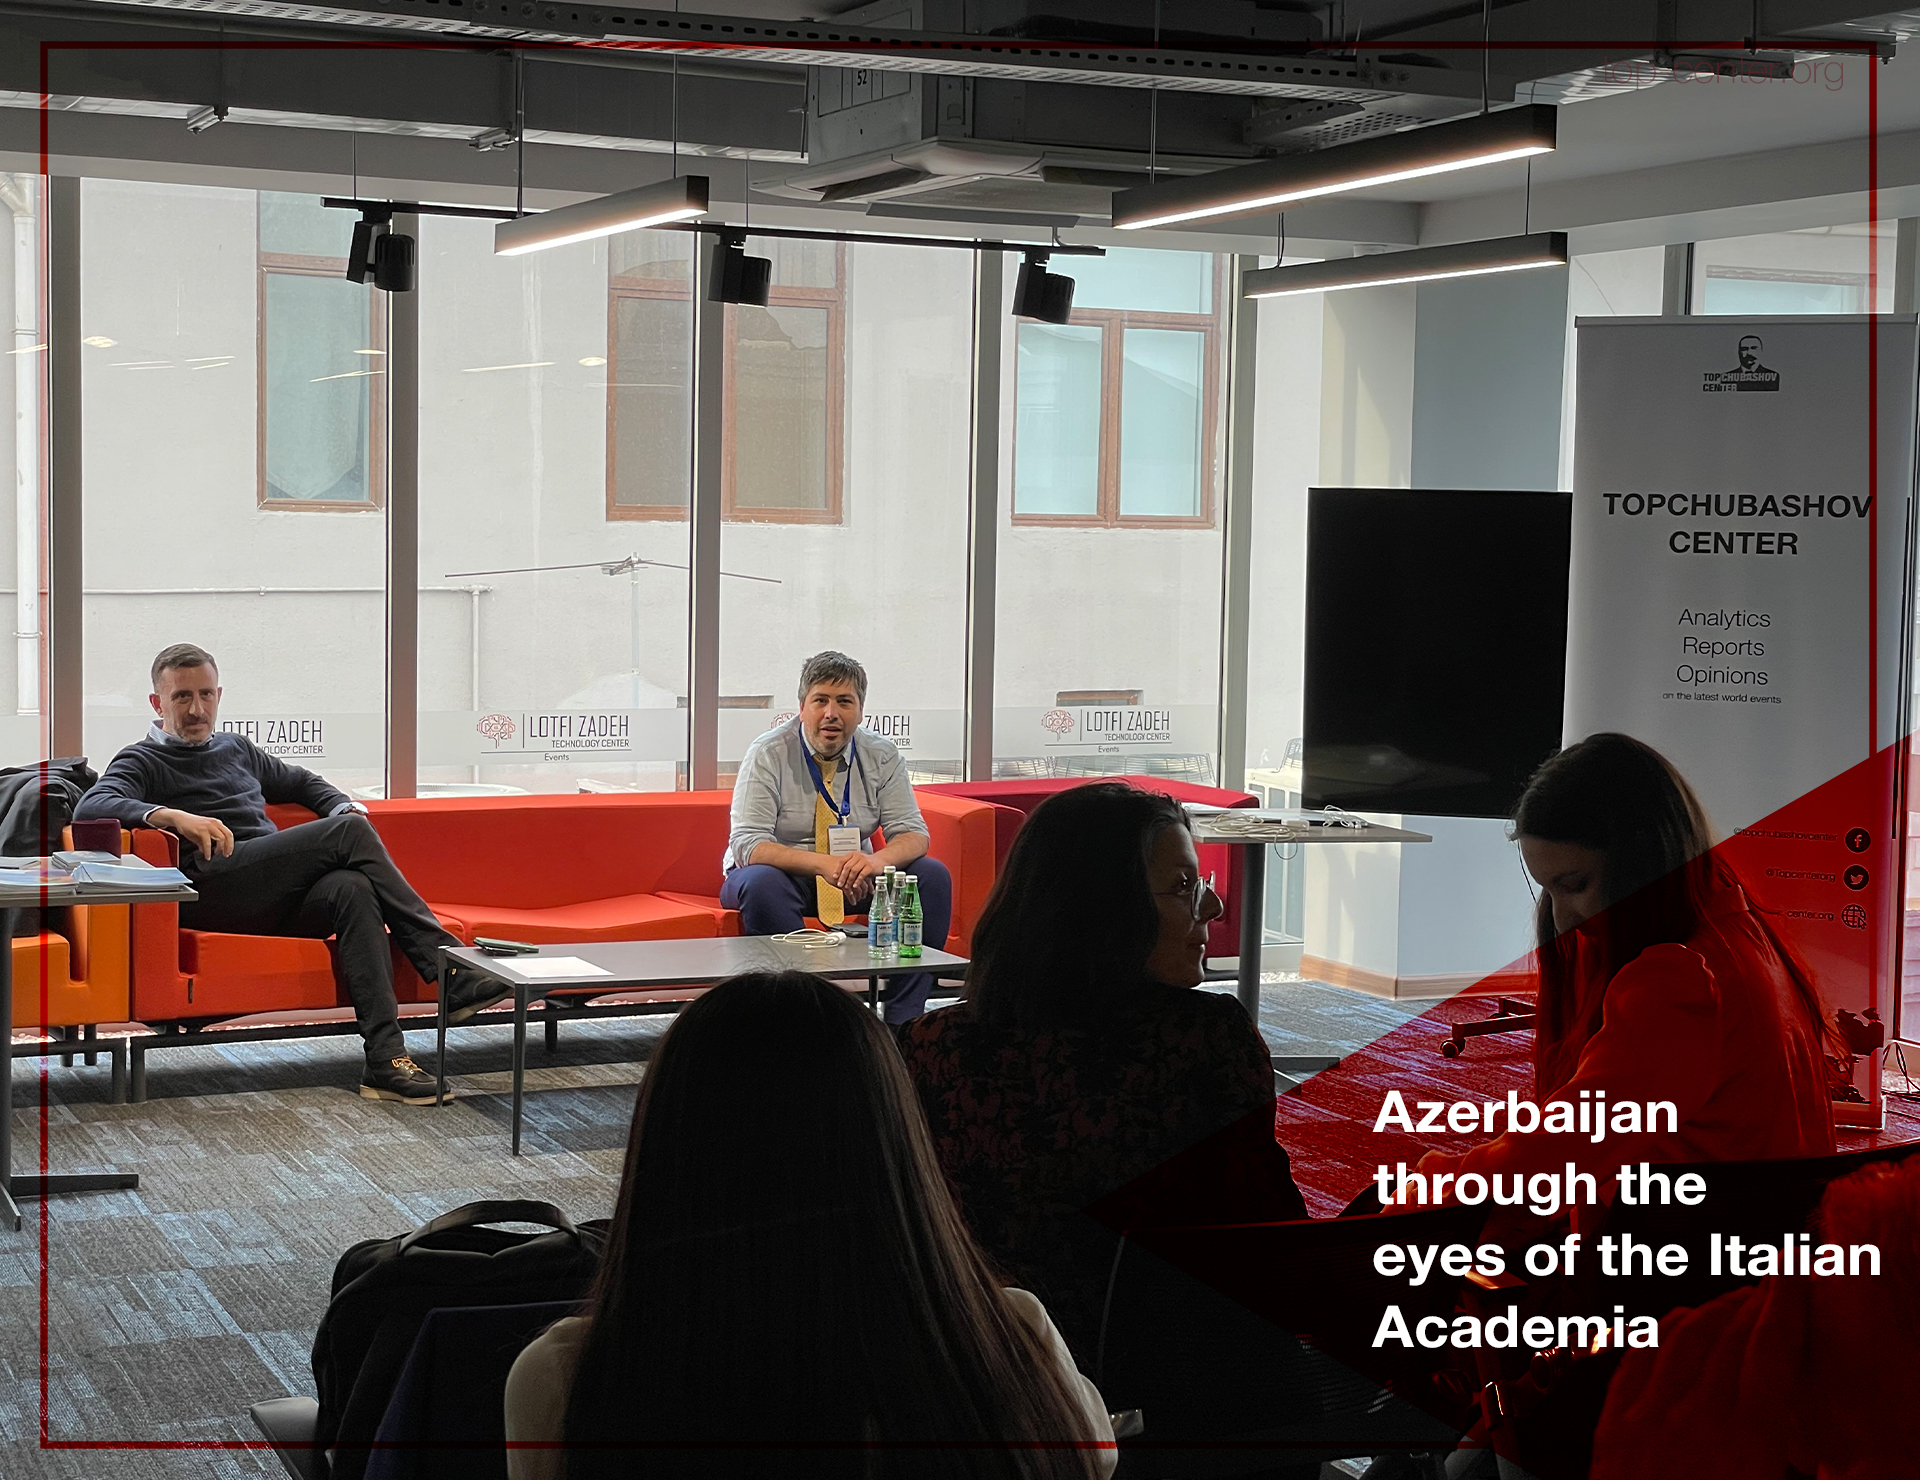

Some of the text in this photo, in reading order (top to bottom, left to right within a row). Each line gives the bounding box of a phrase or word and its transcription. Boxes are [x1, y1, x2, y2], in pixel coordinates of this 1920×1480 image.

[1702, 383, 1738, 392] CENTER
[1602, 493, 1874, 518] TOPCHUBASHOV
[1669, 531, 1798, 555] CENTER
[1678, 608, 1771, 631] Analytics
[1683, 636, 1765, 658] Reports
[1676, 664, 1768, 687] Opinions
[1662, 692, 1782, 704] on the latest world events
[530, 715, 629, 738] LOTFI ZADEH
[864, 715, 910, 736] ZADEH
[1086, 710, 1170, 731] LOTFI ZADEH
[266, 720, 322, 743] ZADEH
[1105, 732, 1171, 741] TECHNOLOGY CENTER
[292, 745, 324, 754] CENTER
[551, 739, 630, 748] TECHNOLOGY CENTER
[1098, 745, 1120, 753] Events
[544, 753, 570, 761] Events
[1733, 827, 1838, 841] @topchubashovcenter
